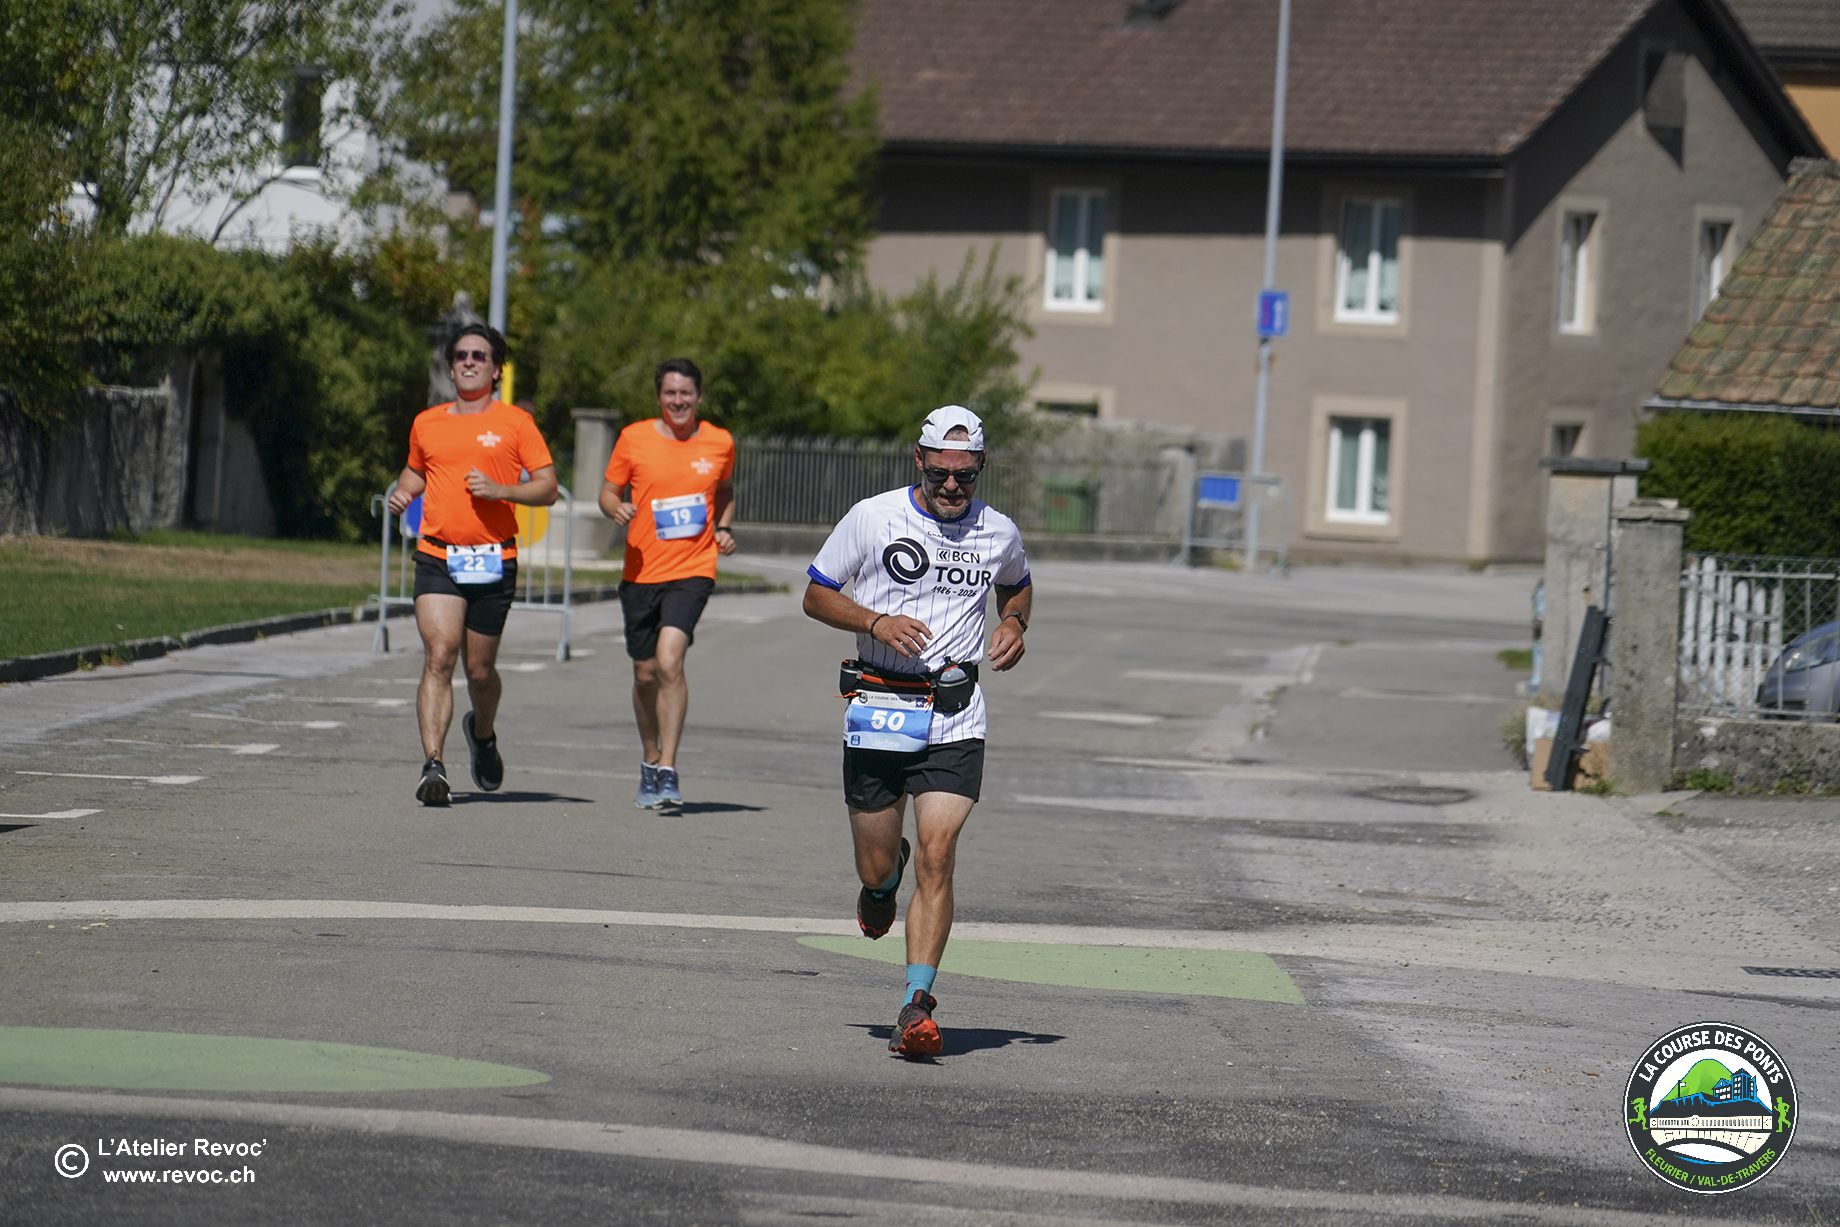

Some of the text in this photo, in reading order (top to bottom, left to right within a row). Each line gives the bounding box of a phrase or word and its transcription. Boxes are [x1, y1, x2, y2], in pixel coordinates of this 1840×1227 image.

[670, 508, 691, 526] 19
[463, 556, 486, 571] 22
[952, 550, 980, 564] BCN
[934, 566, 991, 587] TOUR
[931, 585, 951, 596] 1986
[957, 588, 977, 597] 2026
[870, 710, 906, 731] 50
